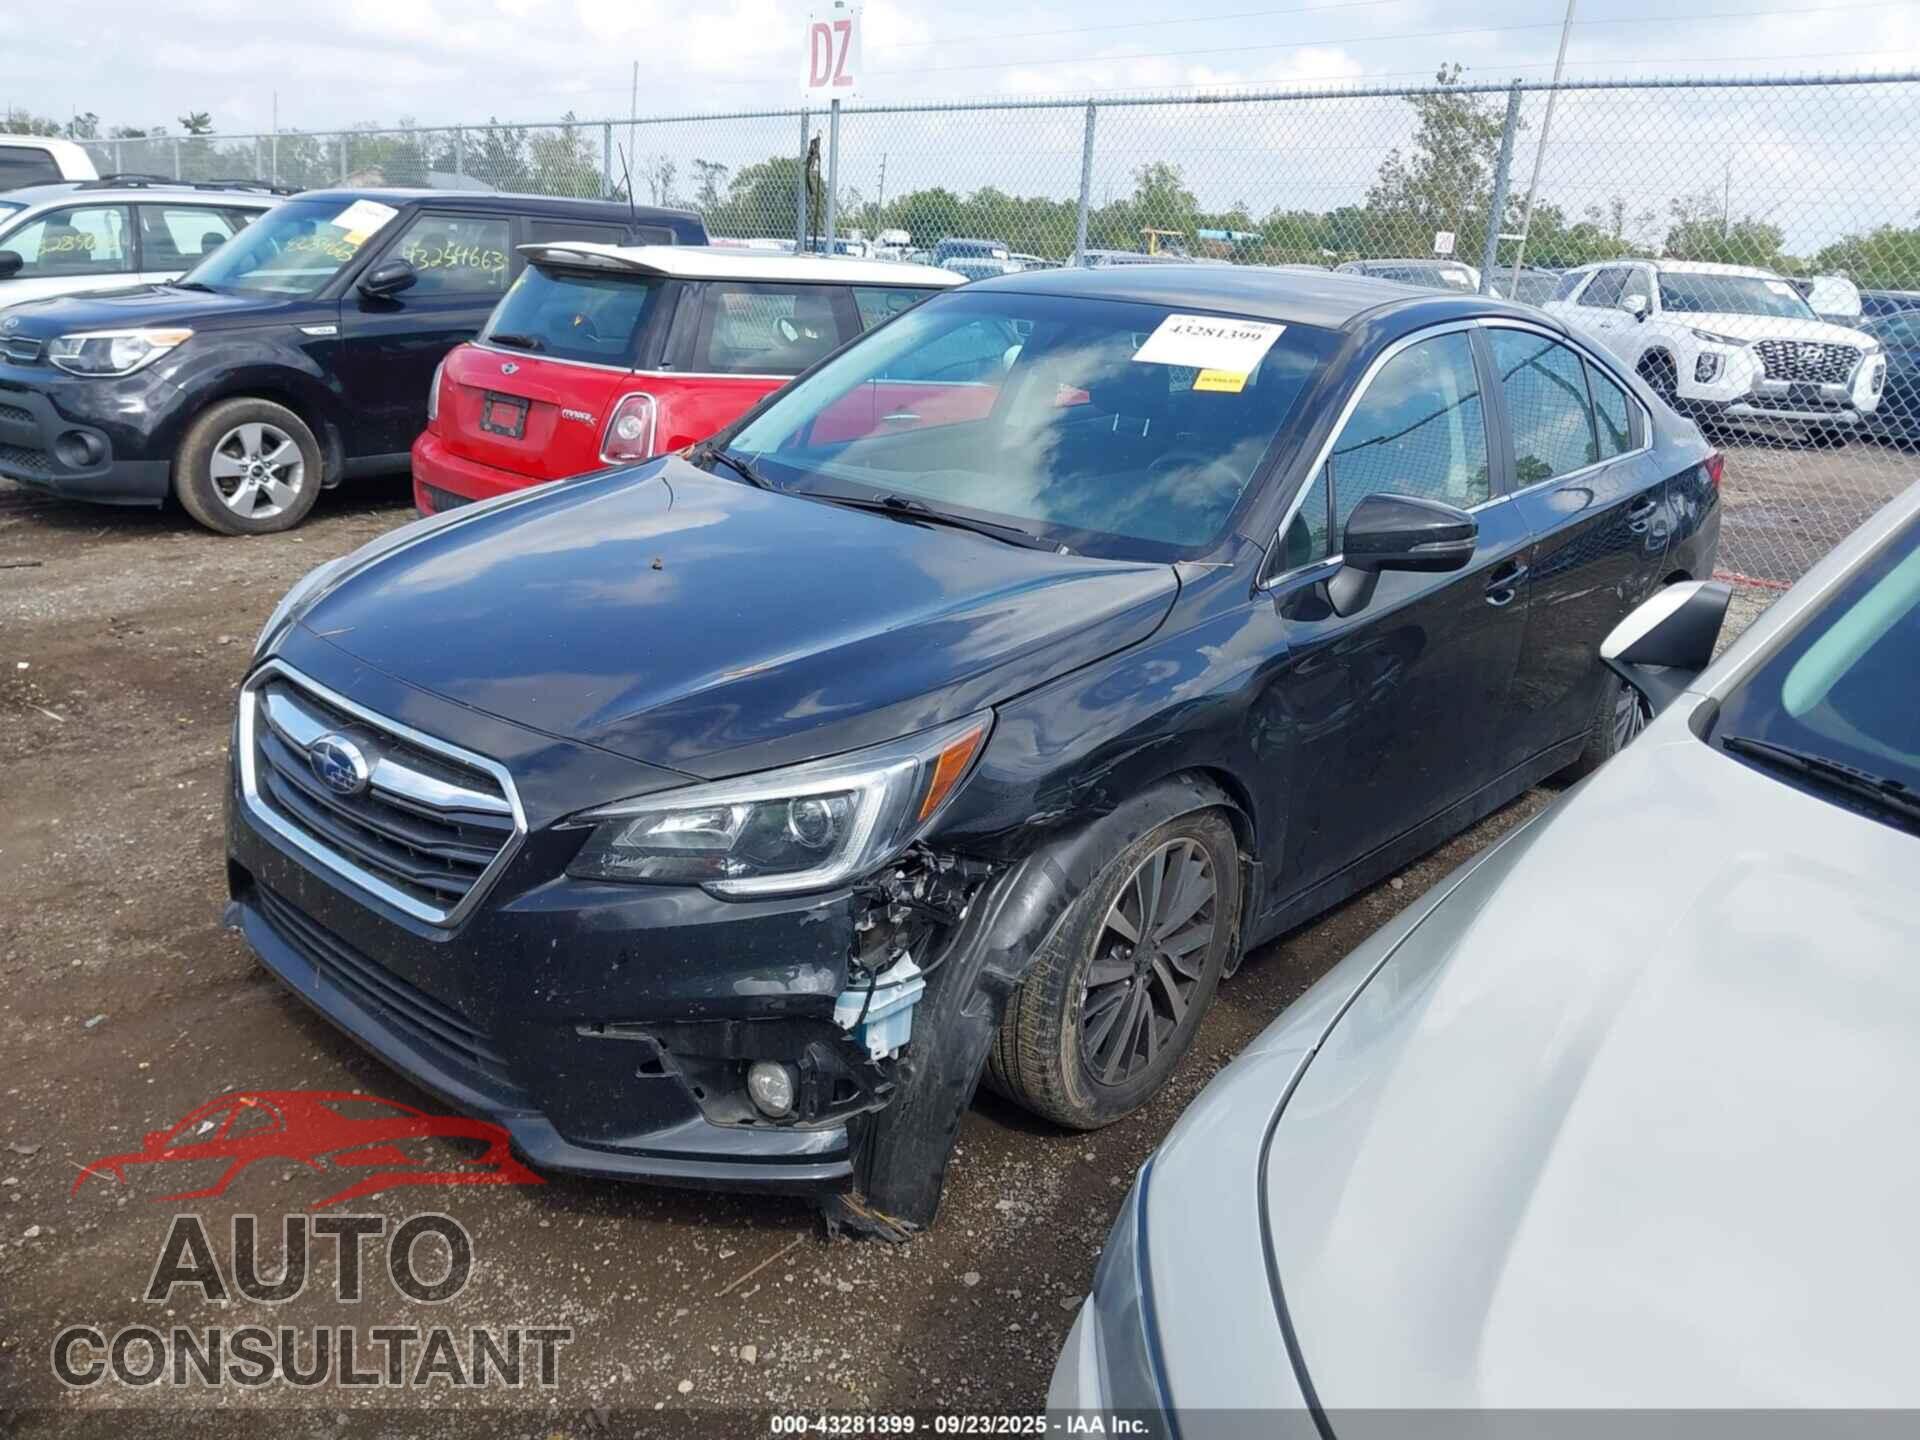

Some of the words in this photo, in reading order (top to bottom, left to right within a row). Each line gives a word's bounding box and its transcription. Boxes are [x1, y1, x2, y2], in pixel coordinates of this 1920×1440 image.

[809, 20, 853, 88] DZ
[401, 245, 505, 273] 43254663
[1169, 325, 1262, 341] 43281399
